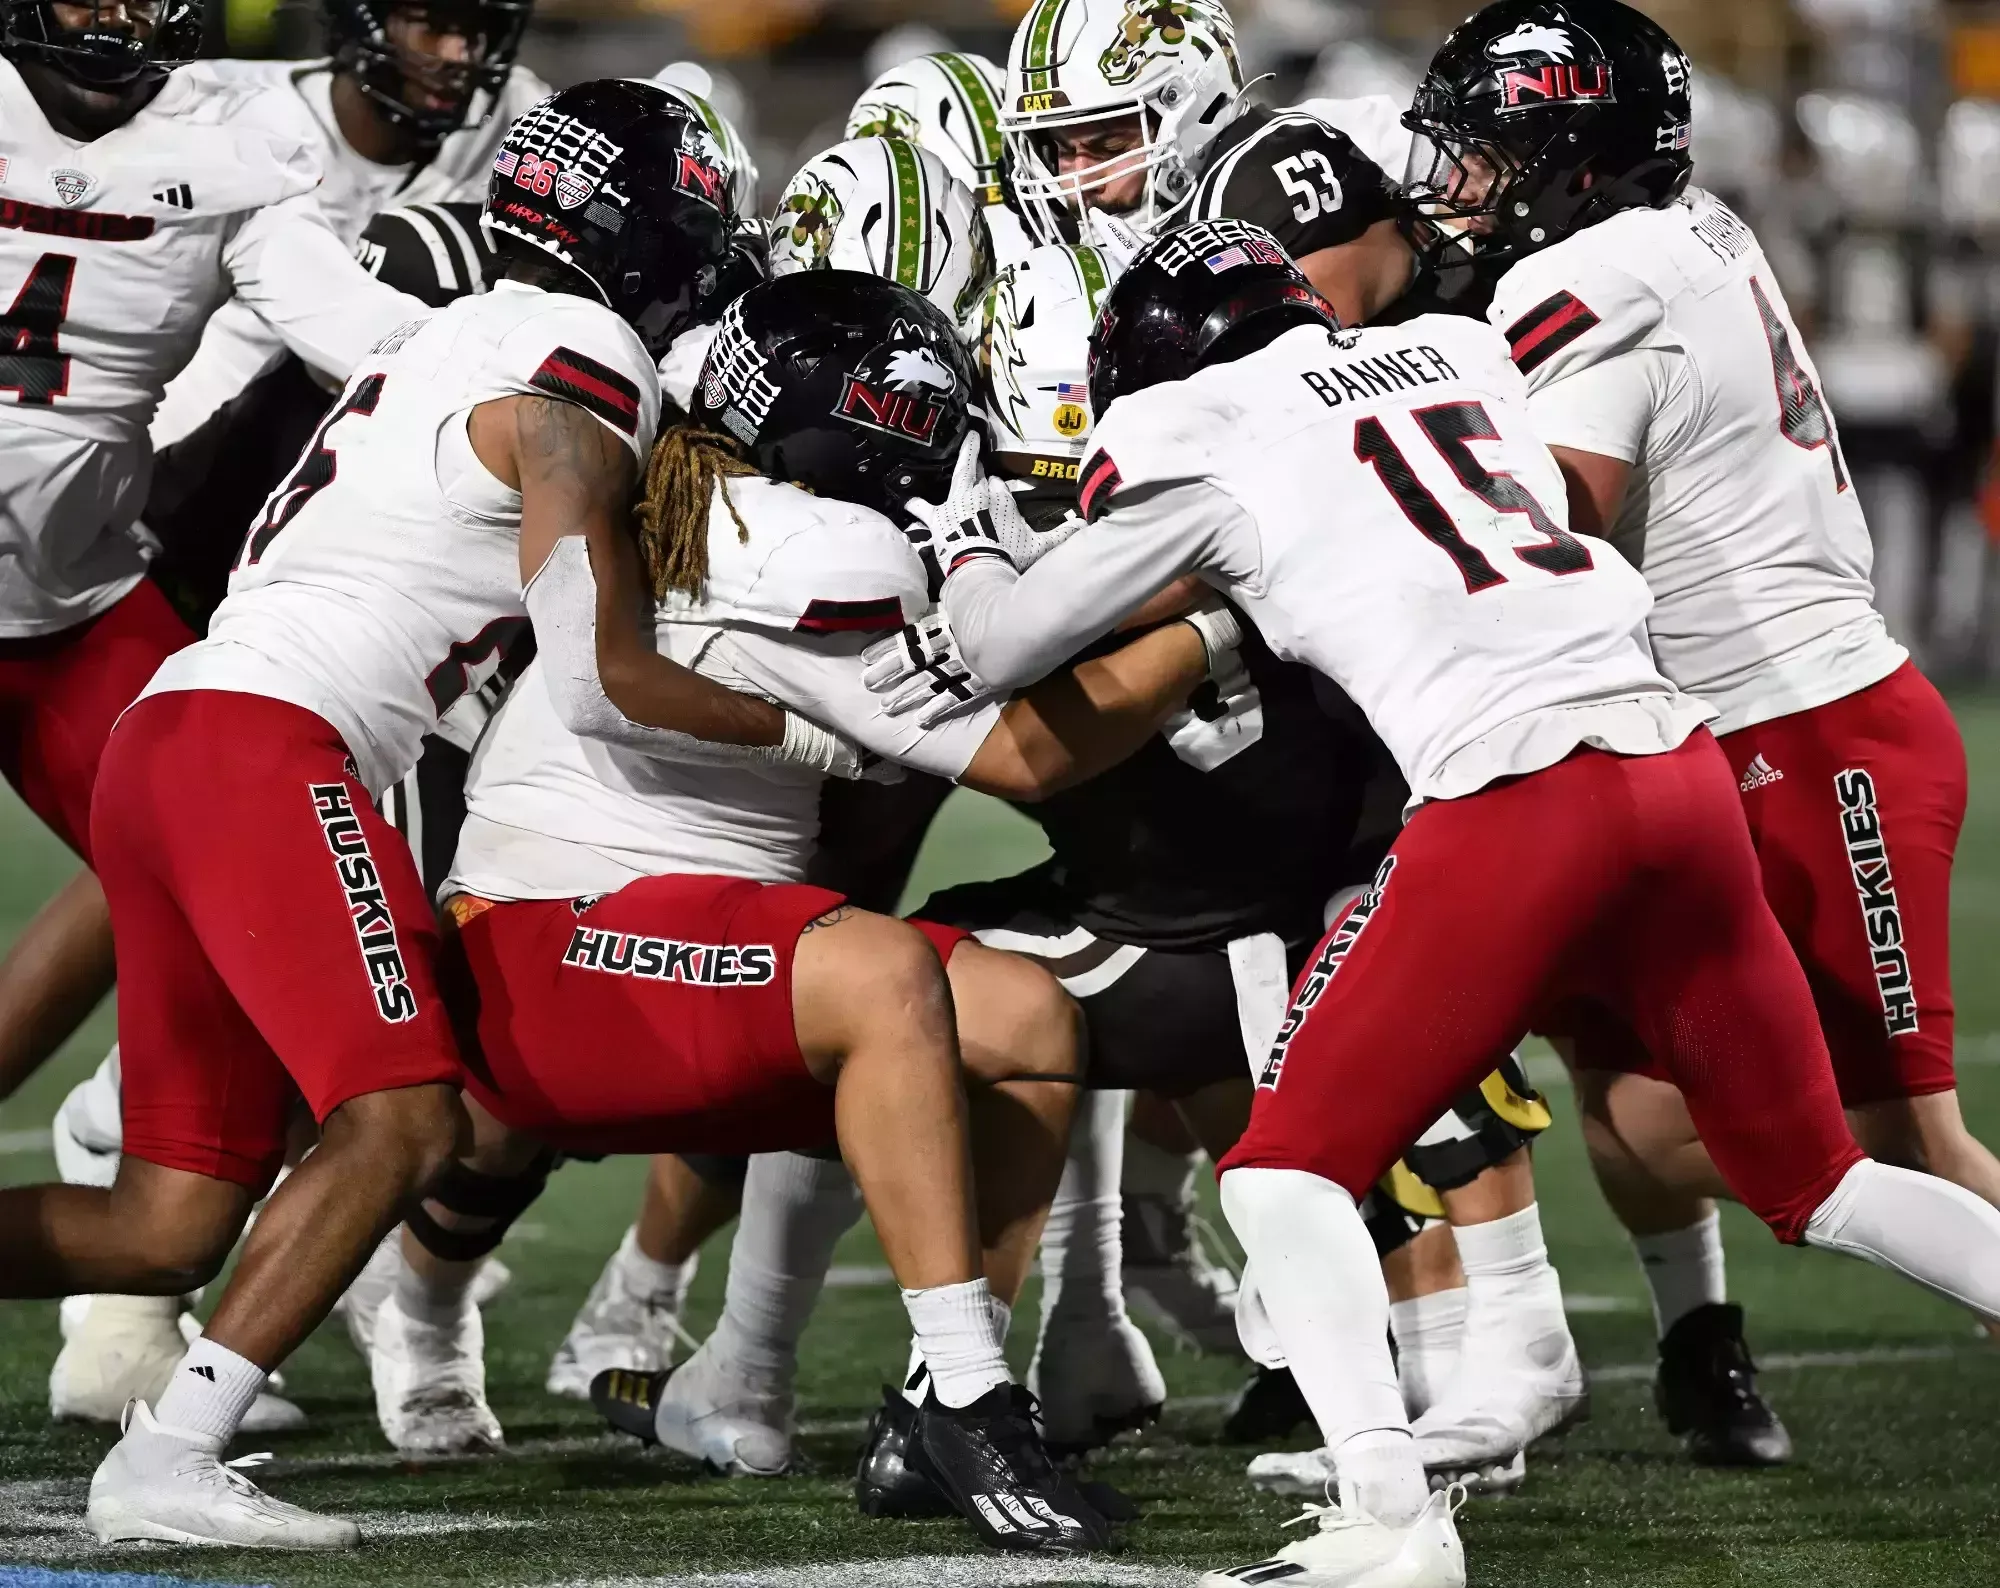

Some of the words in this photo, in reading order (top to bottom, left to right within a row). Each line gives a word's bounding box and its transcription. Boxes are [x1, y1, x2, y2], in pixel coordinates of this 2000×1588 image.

[1023, 93, 1053, 112] EAT
[1504, 65, 1608, 105] NIU
[514, 153, 557, 197] 26
[1272, 150, 1344, 223] 53
[0, 197, 156, 242] USKIES
[504, 203, 543, 224] HARD
[545, 222, 579, 243] WAY
[1107, 222, 1134, 250] ADIZERO
[1242, 241, 1284, 265] 15
[0, 252, 78, 405] 4
[1301, 346, 1460, 407] BANNER
[842, 381, 937, 441] NIU
[1058, 411, 1082, 430] JJ
[1031, 460, 1079, 480] BRO
[1353, 401, 1594, 594] 15
[1740, 769, 1784, 792] adidas
[308, 781, 418, 1025] HUSKIES
[1834, 768, 1919, 1038] HUSKIES
[563, 925, 777, 986] HUSKIES
[1257, 855, 1397, 1092] HUSKIES
